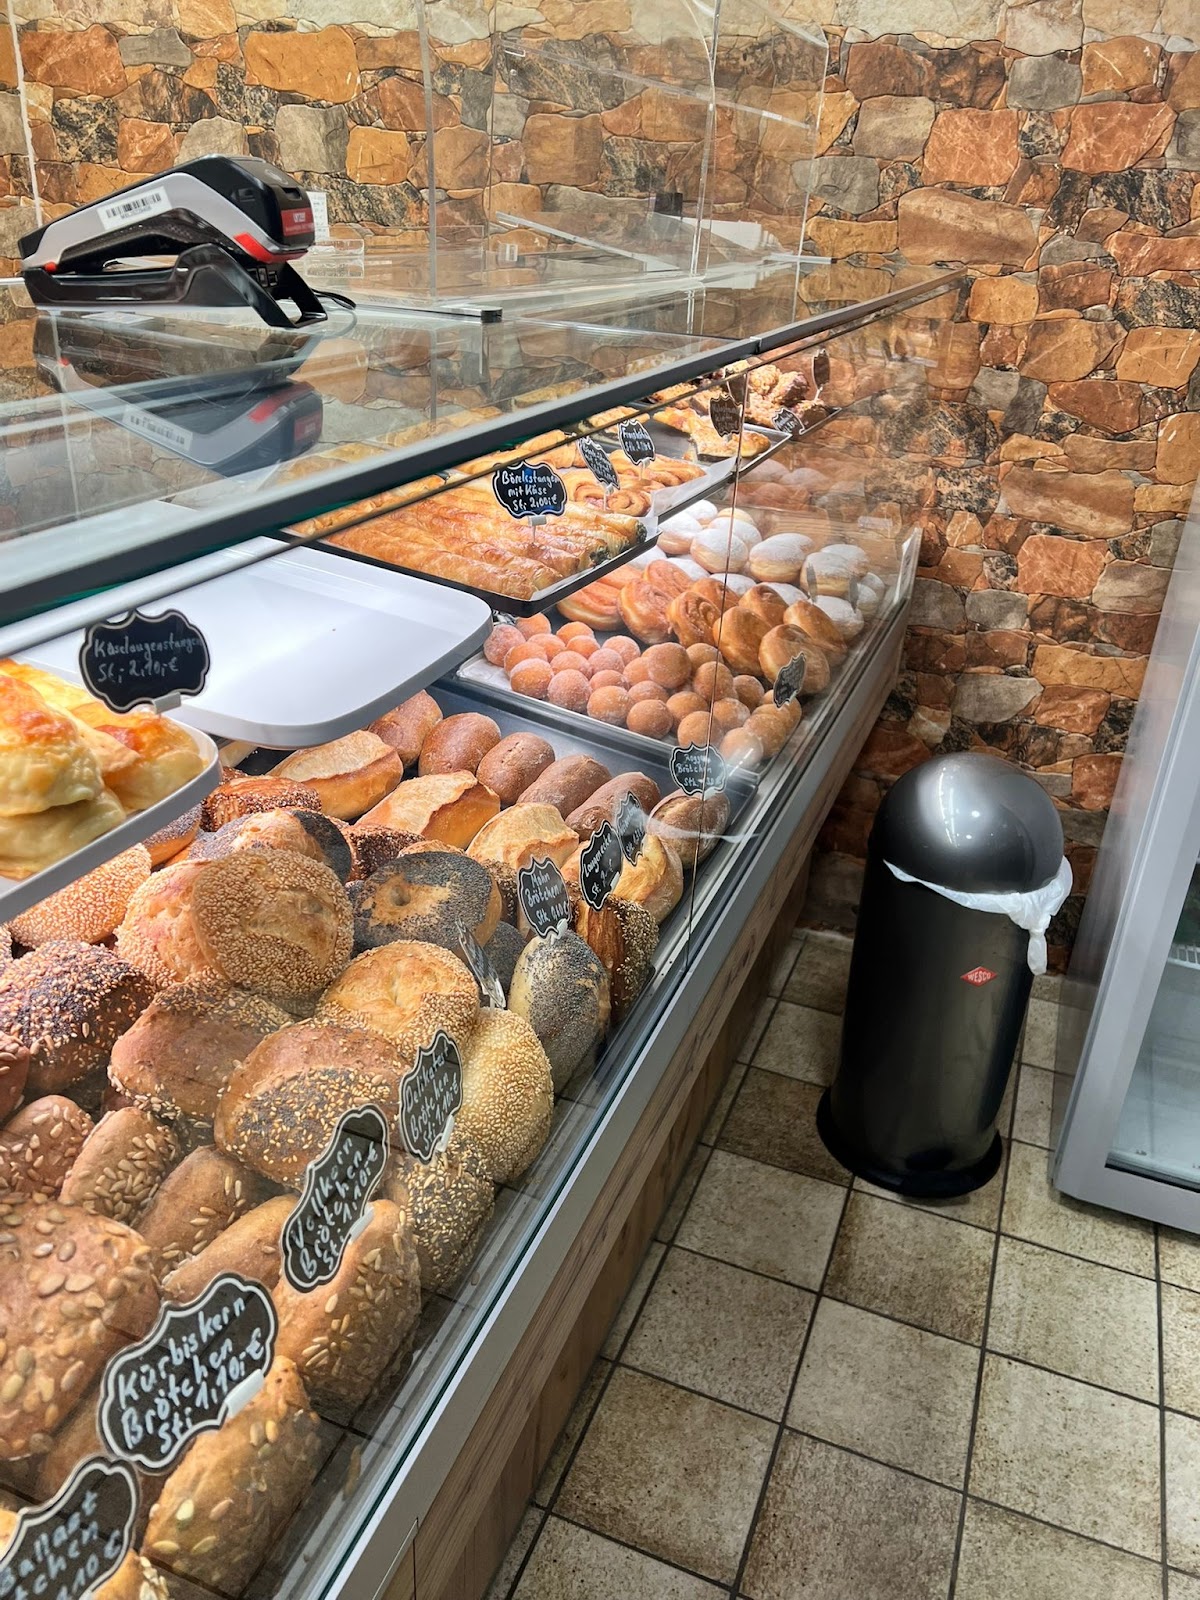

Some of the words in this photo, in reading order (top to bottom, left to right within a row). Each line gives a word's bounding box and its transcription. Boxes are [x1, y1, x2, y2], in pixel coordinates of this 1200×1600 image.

[508, 485, 524, 498] mit
[525, 484, 547, 496] Käse
[676, 763, 712, 774] Brötchn
[967, 970, 992, 983] WESCO
[410, 1071, 449, 1142] Brötchen
[290, 1136, 353, 1249] Vollkorn
[299, 1150, 363, 1279] Brötchen
[121, 1337, 234, 1450] Brötchen
